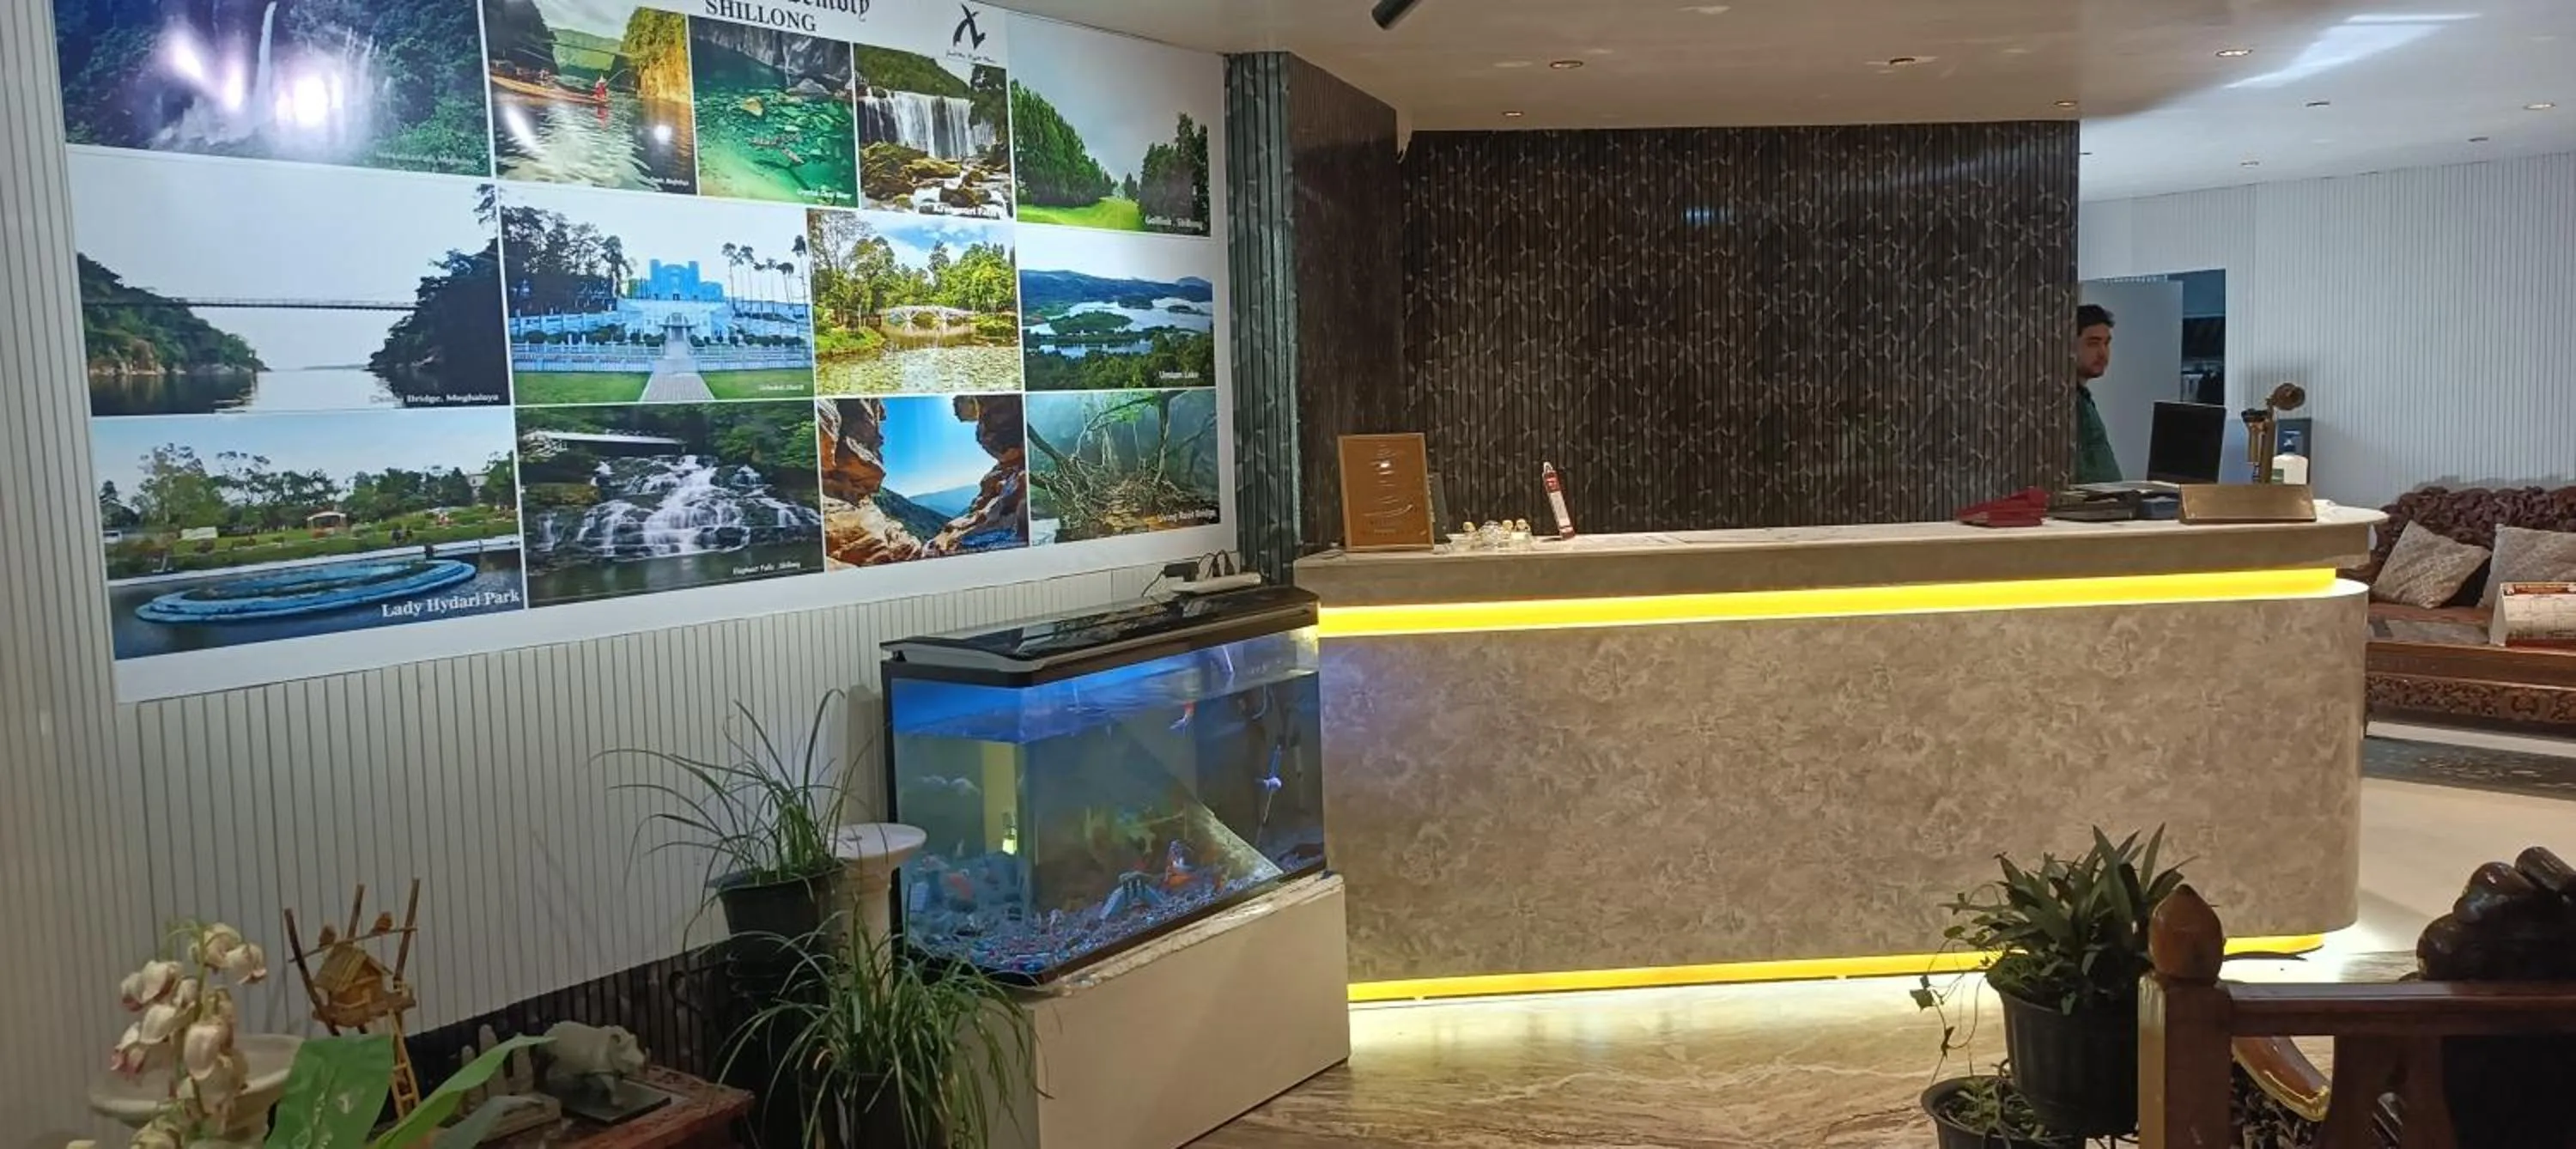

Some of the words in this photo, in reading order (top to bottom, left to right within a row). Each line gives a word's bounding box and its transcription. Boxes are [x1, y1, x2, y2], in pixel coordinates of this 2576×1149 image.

[704, 0, 817, 32] SHILLONG
[407, 393, 444, 404] Bridge,
[447, 393, 499, 403] Meghalaya
[381, 600, 422, 617] Lady
[427, 593, 480, 614] Hydari
[484, 588, 520, 605] Park
